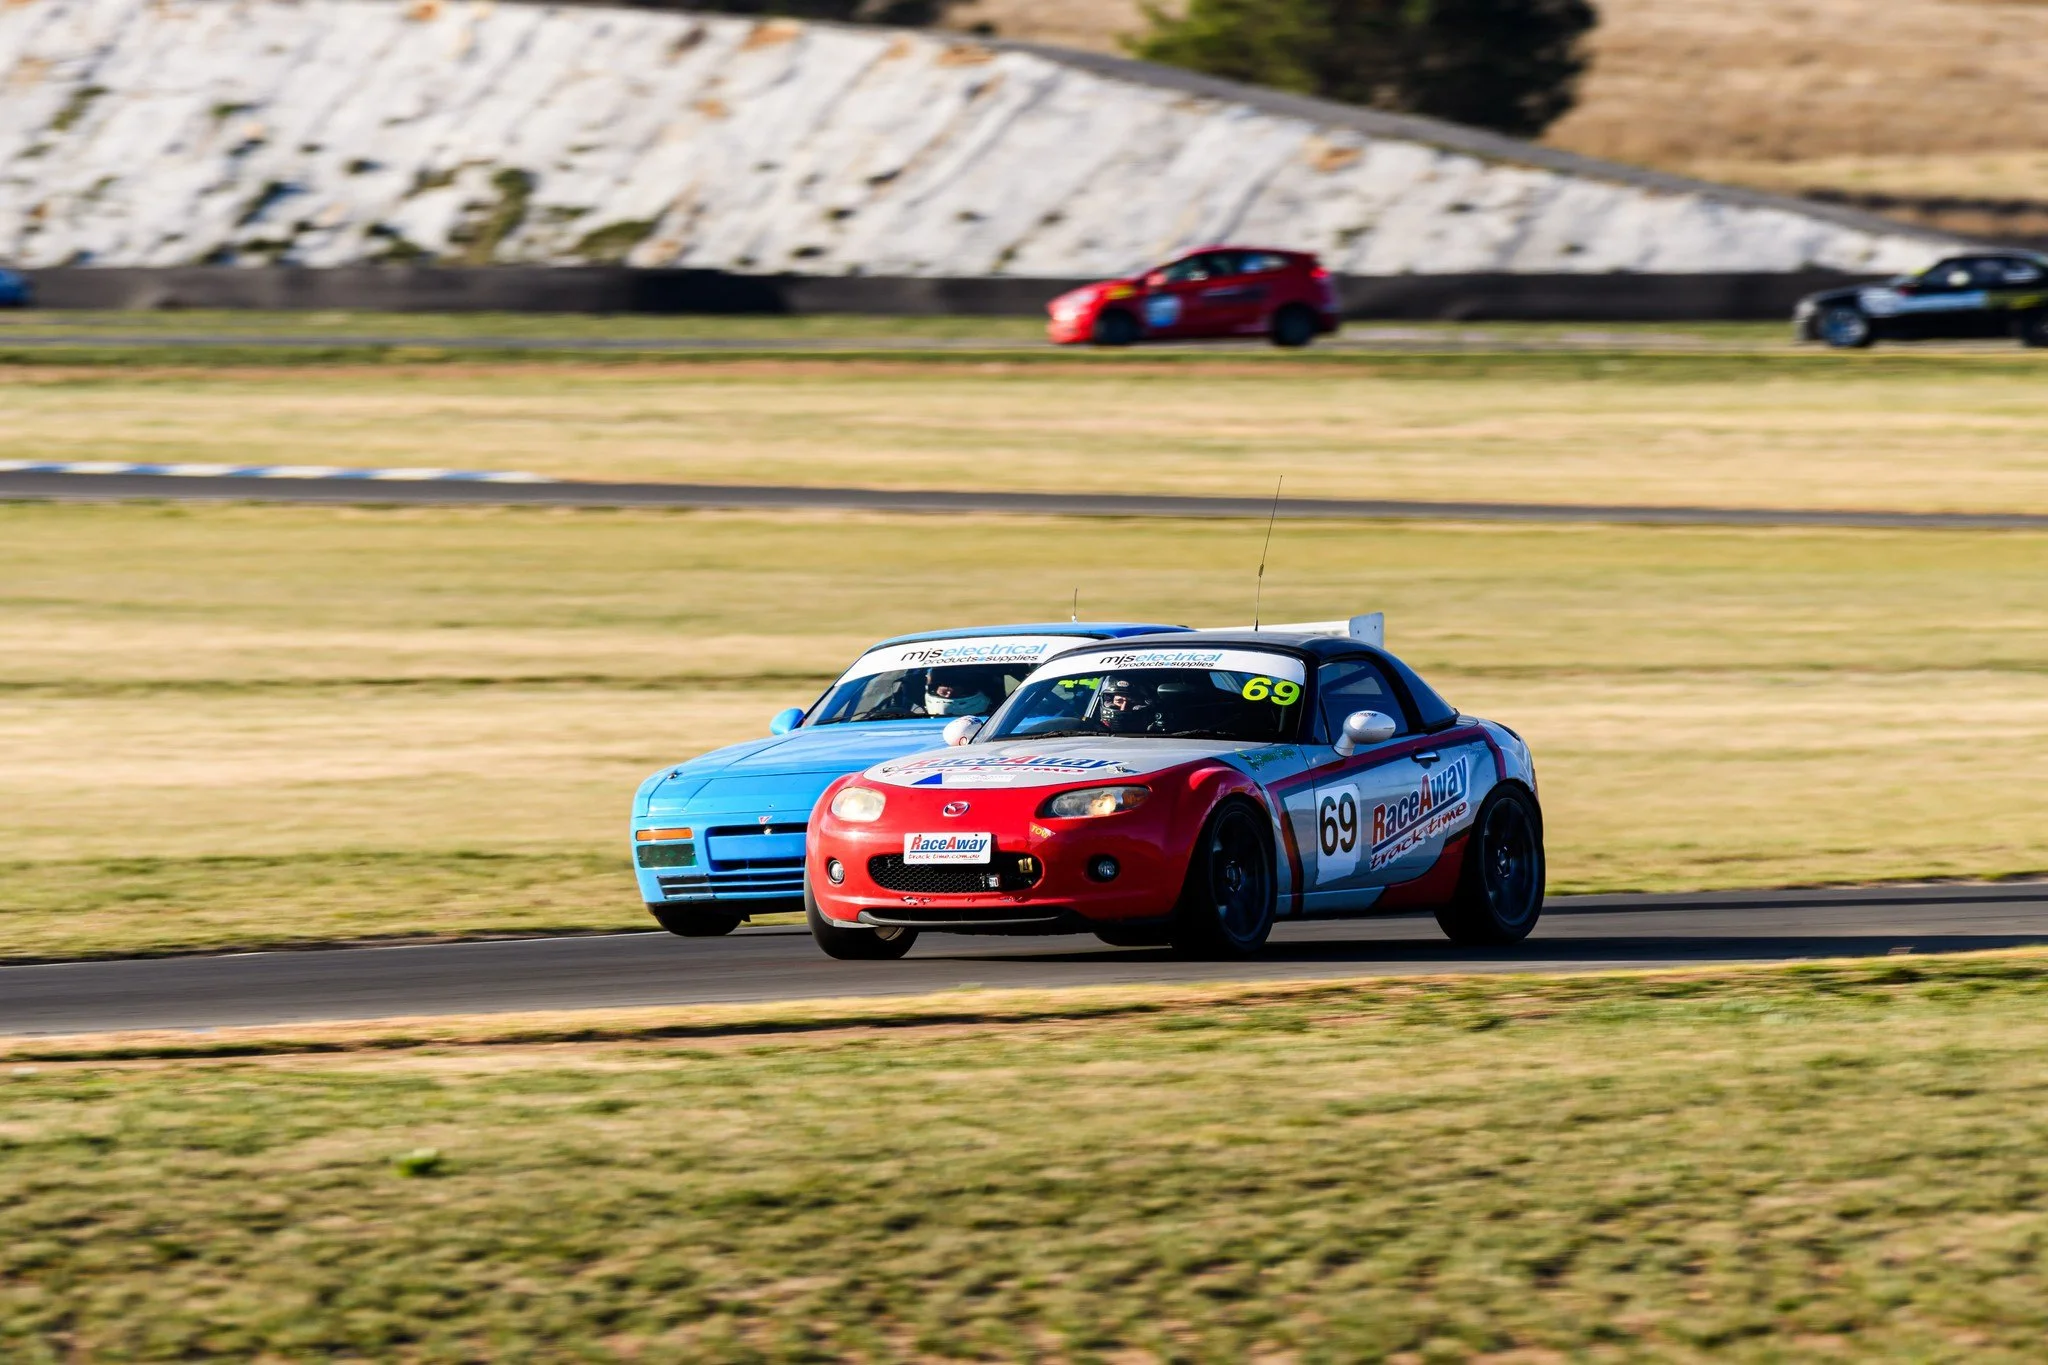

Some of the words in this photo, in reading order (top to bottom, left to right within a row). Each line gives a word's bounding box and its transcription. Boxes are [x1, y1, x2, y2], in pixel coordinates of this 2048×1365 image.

[901, 643, 1048, 662] mjselectrical
[1100, 652, 1223, 664] mjselectrical
[1242, 677, 1300, 706] 69
[1372, 757, 1467, 846] RaceAway
[1031, 824, 1049, 839] TOW
[1320, 792, 1357, 857] 69
[1370, 829, 1423, 870] track
[1428, 801, 1467, 833] time
[910, 836, 987, 852] RaceAway
